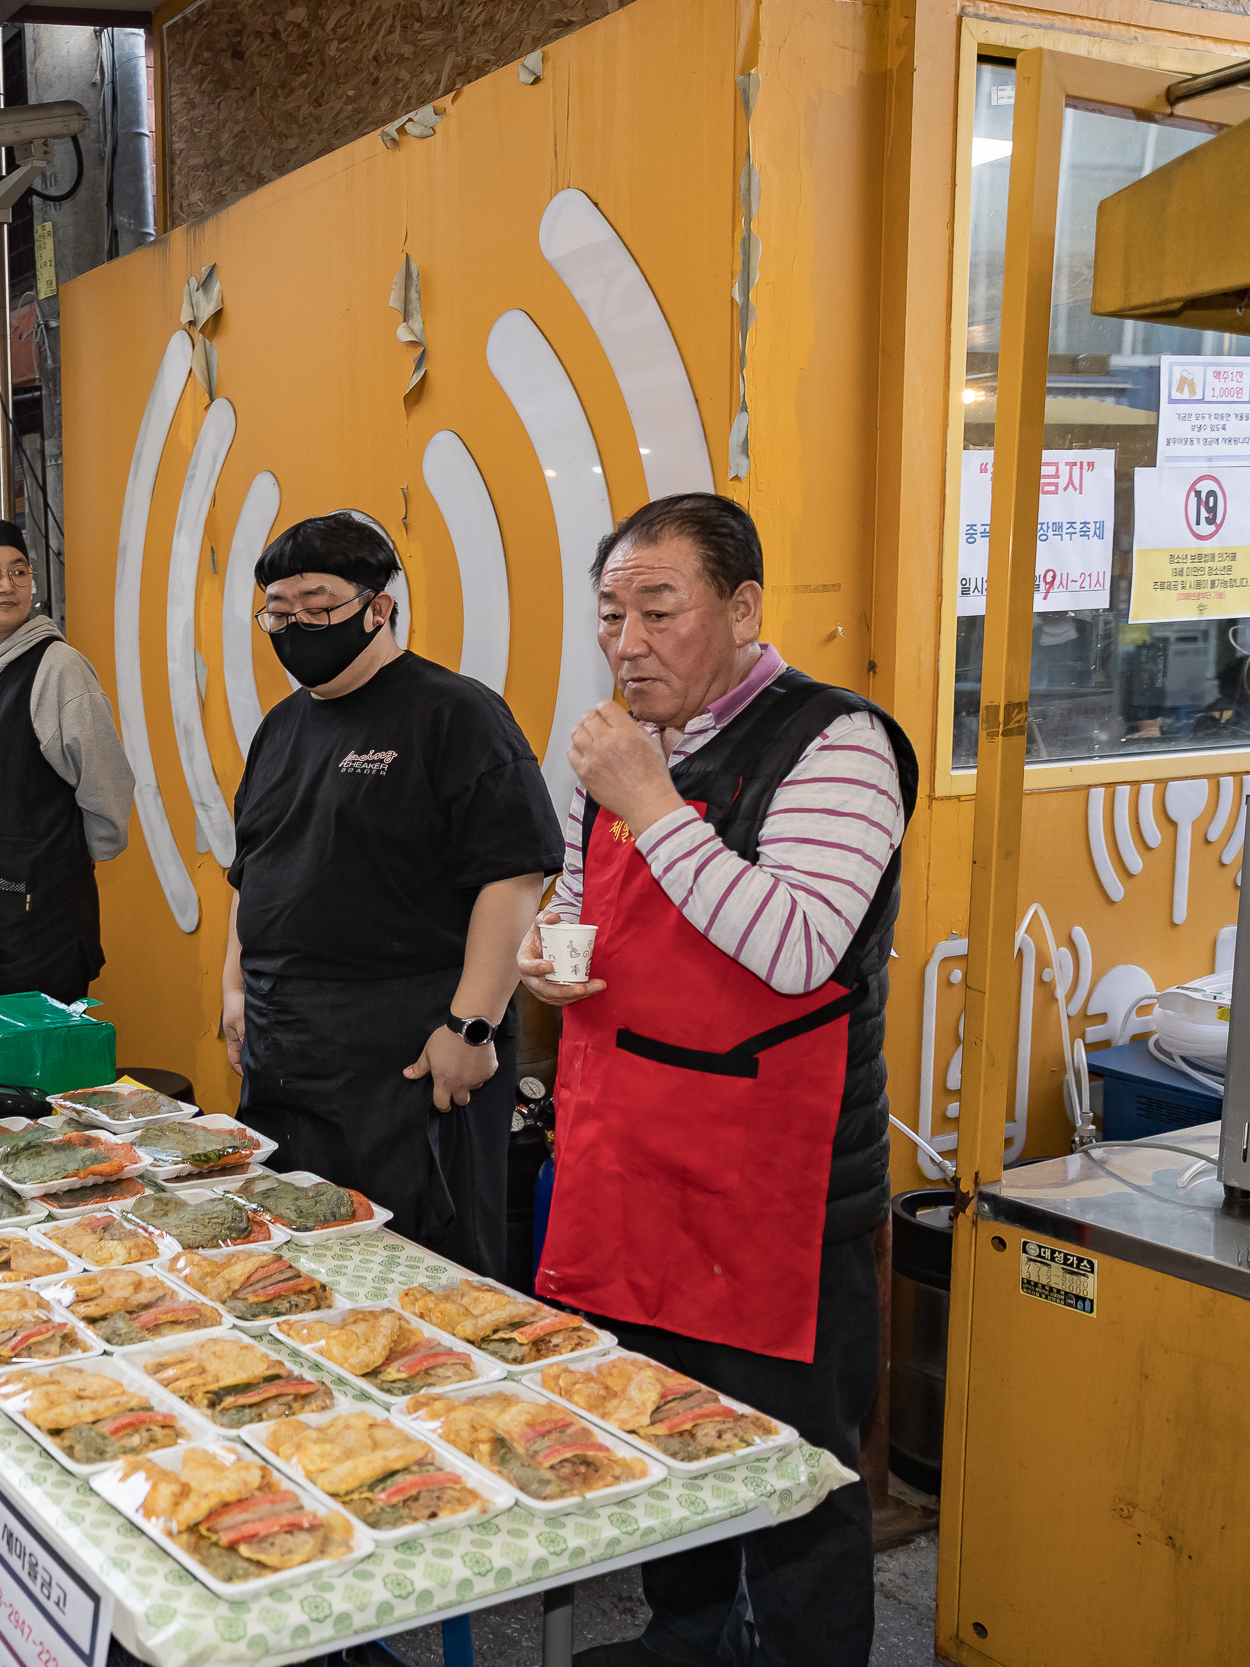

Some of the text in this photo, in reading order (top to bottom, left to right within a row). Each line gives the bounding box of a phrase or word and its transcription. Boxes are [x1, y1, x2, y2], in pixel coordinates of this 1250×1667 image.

[1211, 386, 1244, 400] 1,000원
[1195, 489, 1219, 526] 19
[1168, 553, 1188, 564] 청소년
[1186, 566, 1206, 576] 미만의
[1207, 565, 1232, 576] 청소년은
[1180, 580, 1187, 590] 및
[1040, 1247, 1092, 1272] 대성가스
[1, 1523, 68, 1616] 새마을금고
